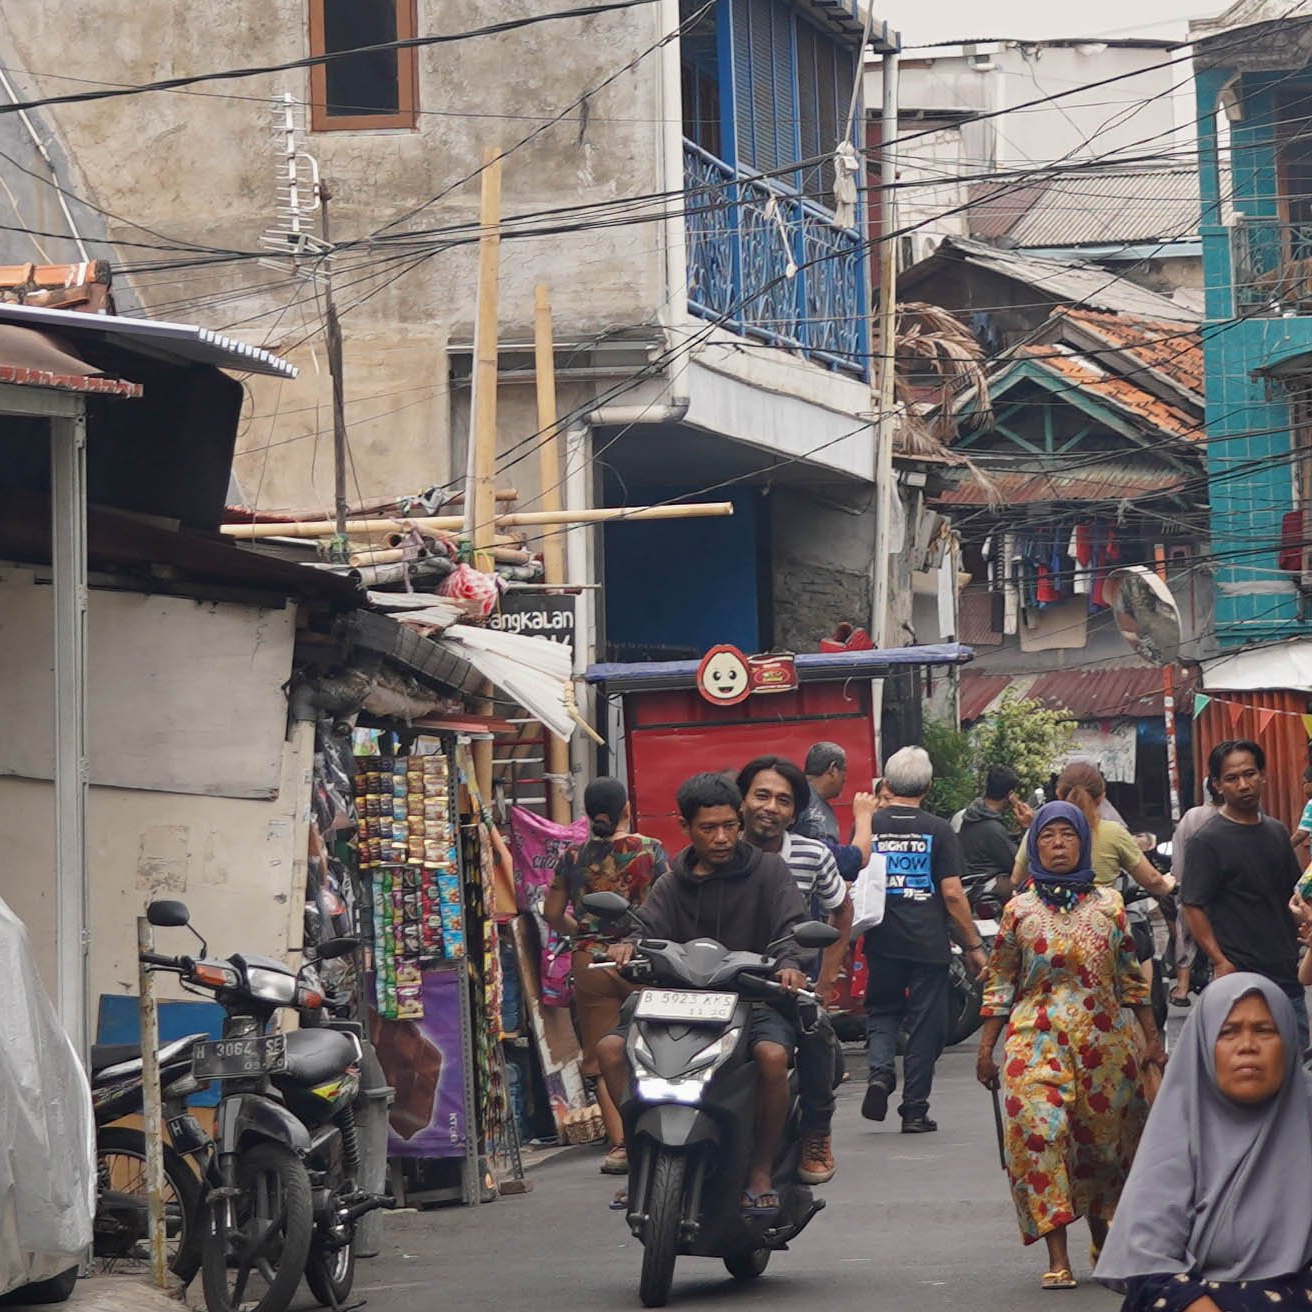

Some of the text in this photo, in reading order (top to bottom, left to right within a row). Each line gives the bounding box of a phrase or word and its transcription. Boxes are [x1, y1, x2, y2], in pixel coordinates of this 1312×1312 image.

[910, 840, 927, 853] TO
[888, 856, 928, 870] NOW
[888, 875, 906, 887] AY
[216, 1041, 252, 1057] 3064
